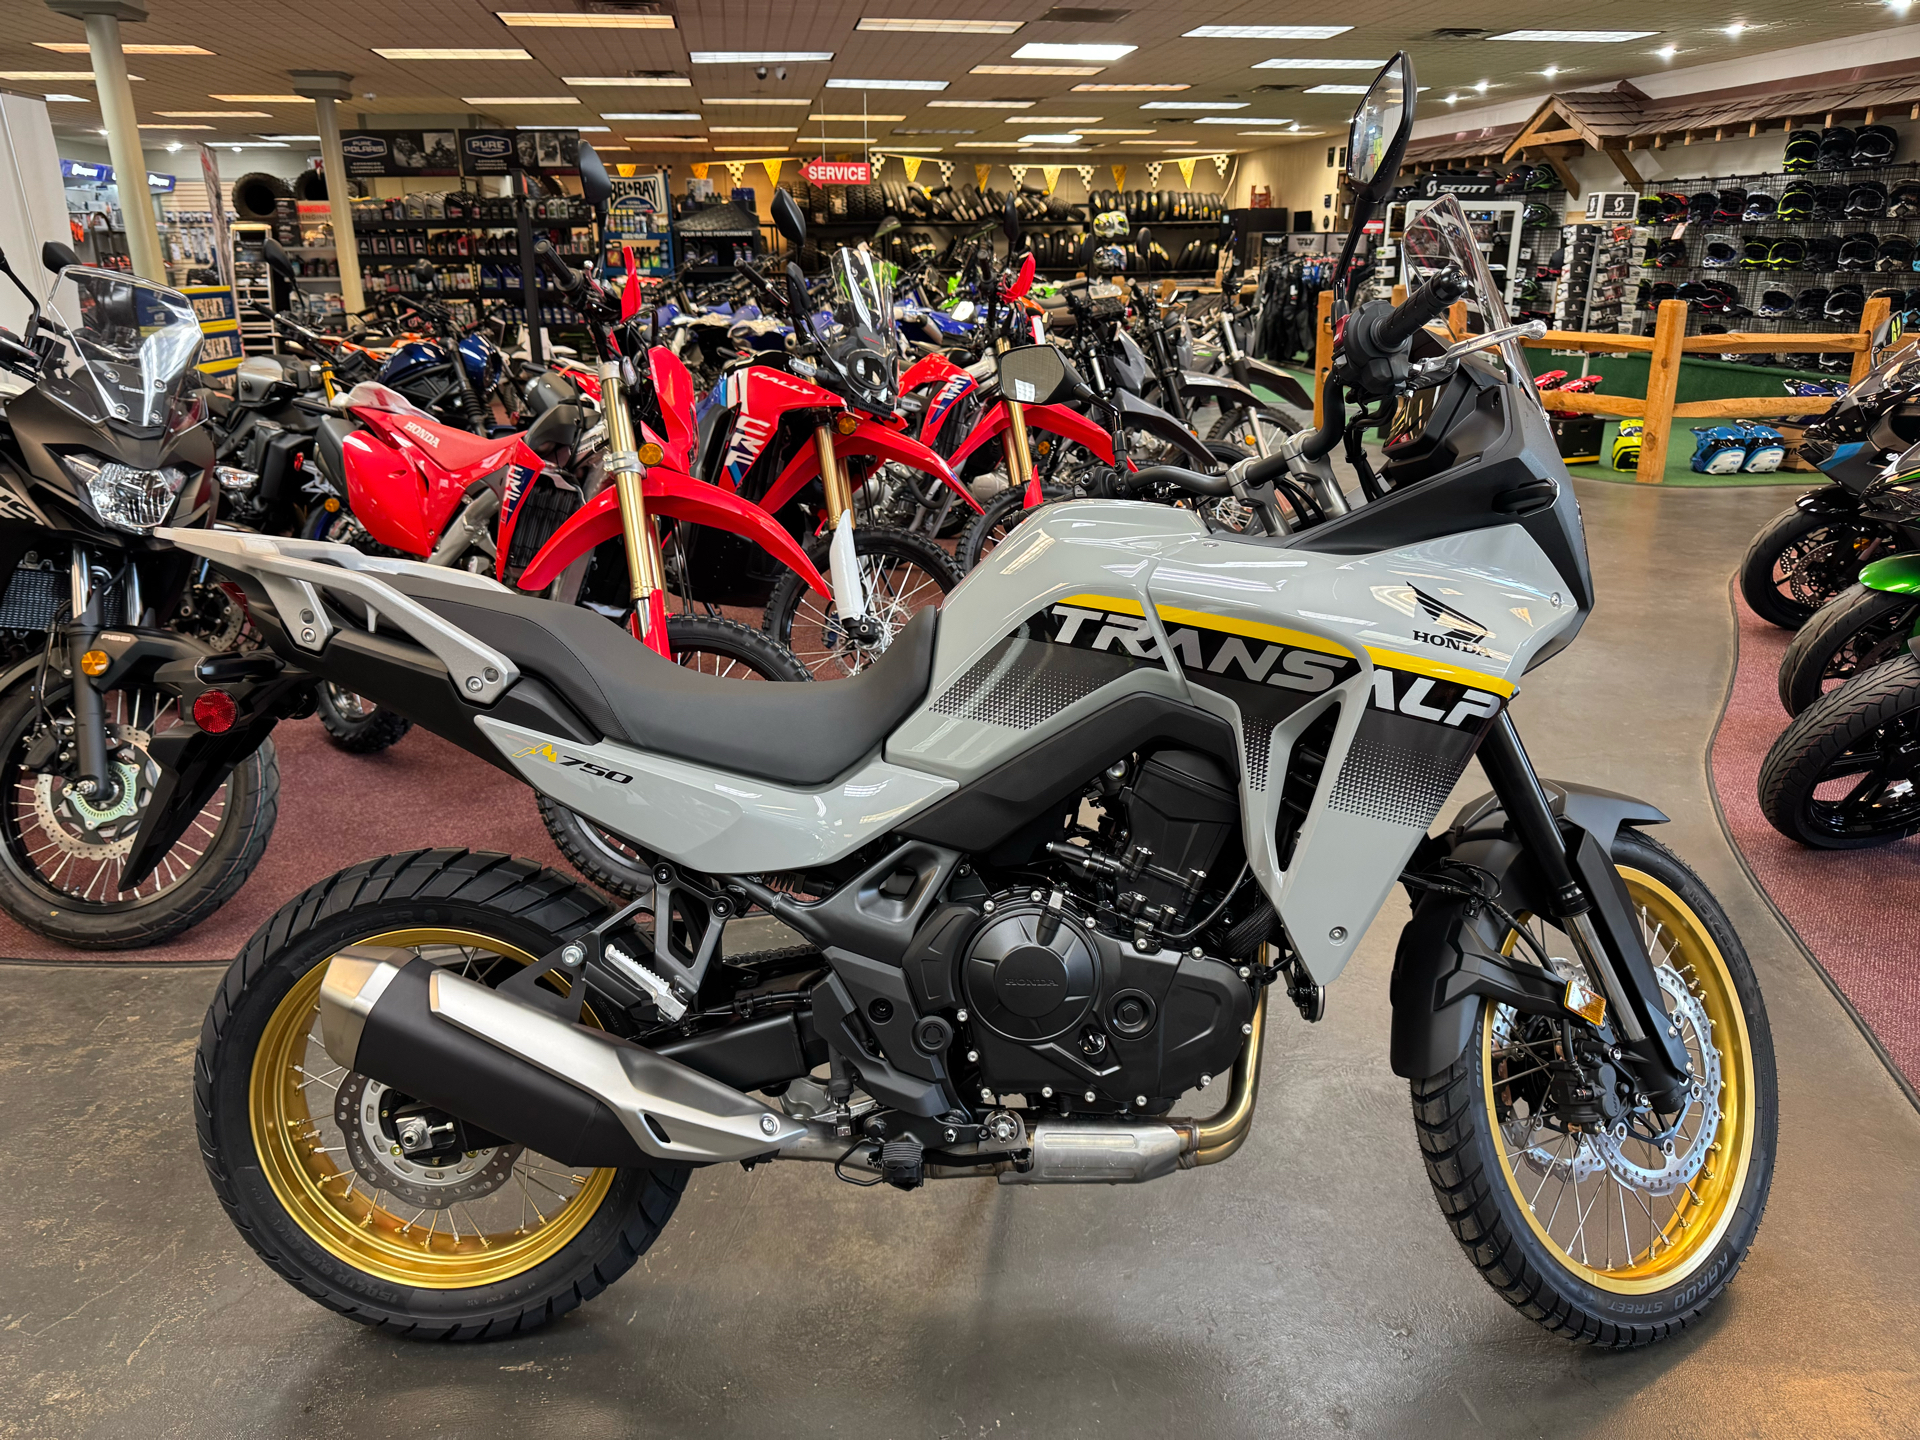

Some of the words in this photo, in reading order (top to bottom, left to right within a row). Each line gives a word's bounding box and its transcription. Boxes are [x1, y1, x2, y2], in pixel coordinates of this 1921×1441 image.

[343, 145, 386, 153] POLARIS
[471, 140, 506, 149] PURE
[808, 166, 867, 181] SERVICE
[1437, 184, 1491, 193] SCOTT
[751, 371, 816, 396] RALLY
[403, 420, 441, 449] HONDA
[101, 633, 131, 643] ABS
[1412, 629, 1493, 659] HONDA
[559, 755, 634, 785] 750
[1005, 977, 1059, 987] HONDA
[1674, 1251, 1729, 1311] KAROO
[1607, 1300, 1664, 1315] STREET
